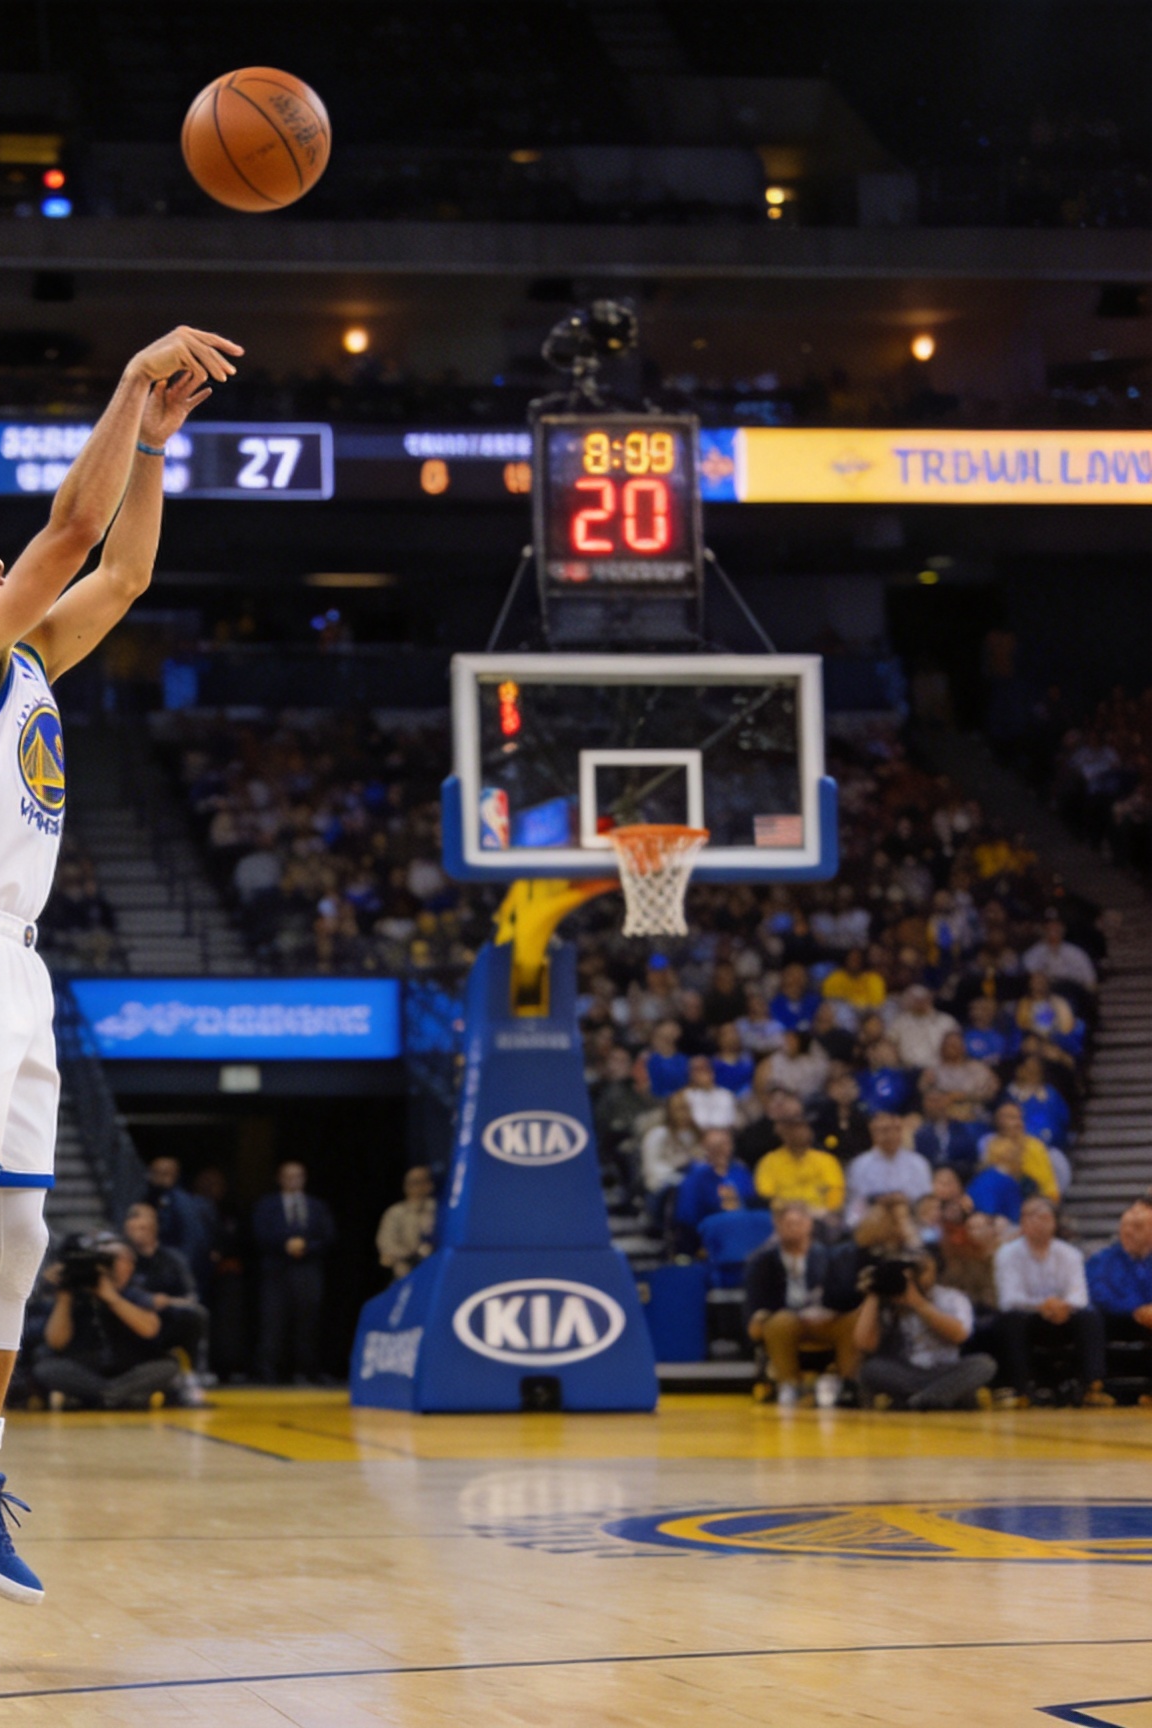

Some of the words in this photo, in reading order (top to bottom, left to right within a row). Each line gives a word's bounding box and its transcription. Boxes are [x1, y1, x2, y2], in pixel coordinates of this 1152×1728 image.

[238, 438, 302, 488] 27
[573, 478, 669, 551] 20
[501, 1121, 570, 1154] KIA
[483, 1294, 599, 1349] KIA
